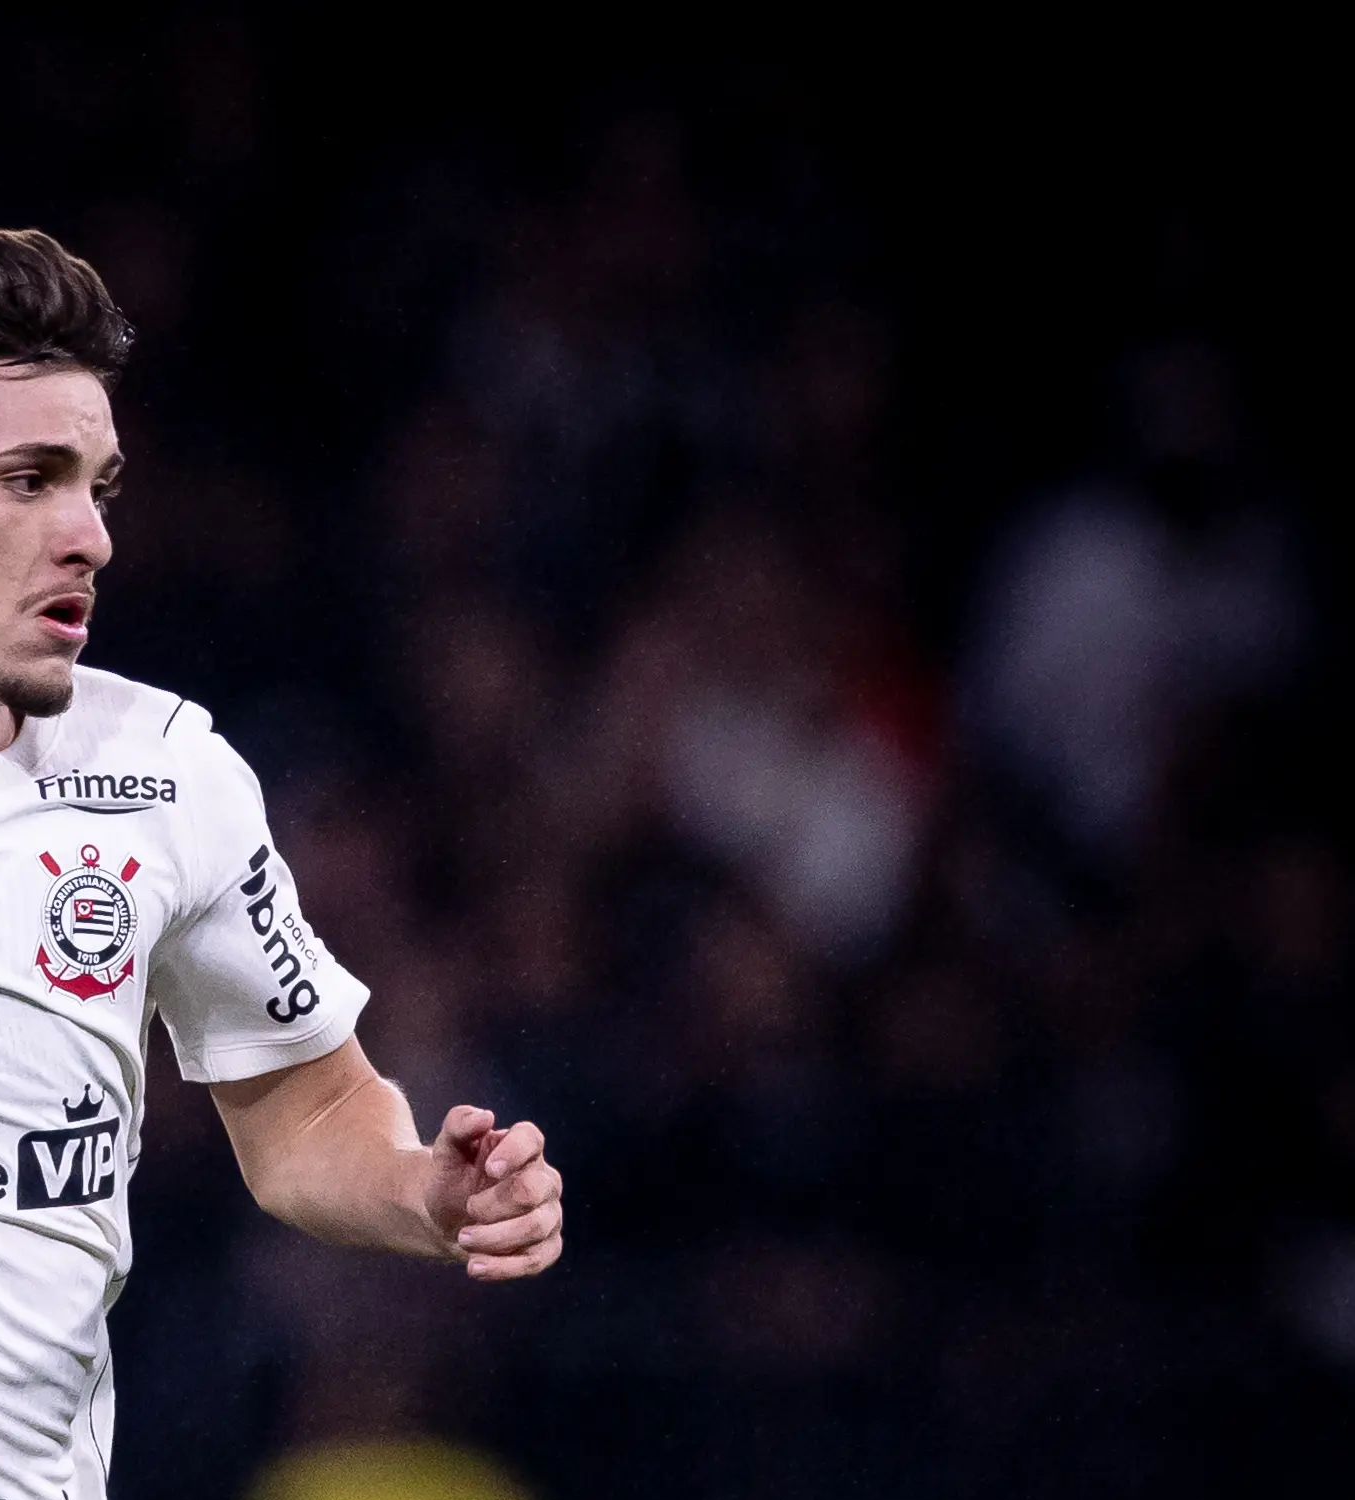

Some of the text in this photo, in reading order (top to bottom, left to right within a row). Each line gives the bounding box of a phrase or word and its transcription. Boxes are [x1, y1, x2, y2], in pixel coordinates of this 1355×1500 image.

[34, 768, 177, 804] Frimesa
[51, 876, 114, 916] CORINTHIANS
[112, 893, 129, 947] PAULISTA
[76, 951, 100, 964] 1910
[246, 883, 320, 1024] bmg
[31, 1131, 115, 1199] VIP
